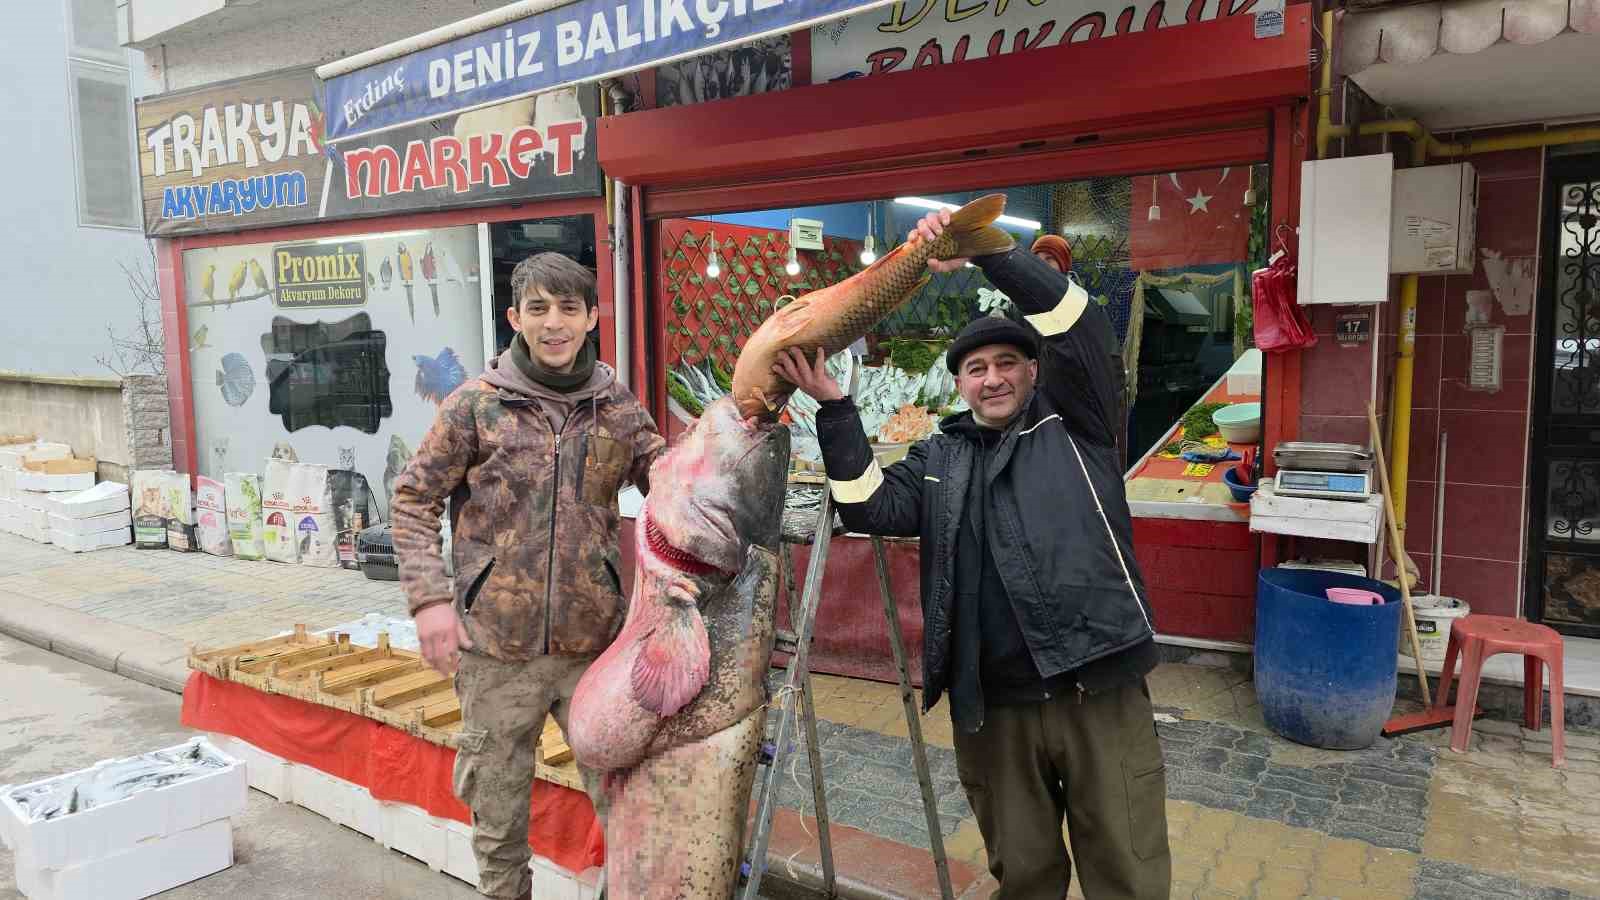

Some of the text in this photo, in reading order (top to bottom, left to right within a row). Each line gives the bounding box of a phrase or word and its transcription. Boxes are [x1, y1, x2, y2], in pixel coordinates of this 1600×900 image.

[343, 65, 406, 129] Erdinç
[428, 28, 543, 99] DENİZ
[147, 100, 319, 178] TRAKYA
[162, 169, 308, 219] AKVARYUM
[277, 246, 362, 283] Promix
[280, 286, 362, 304] Akvaryum Dekoru
[1344, 320, 1361, 333] 17
